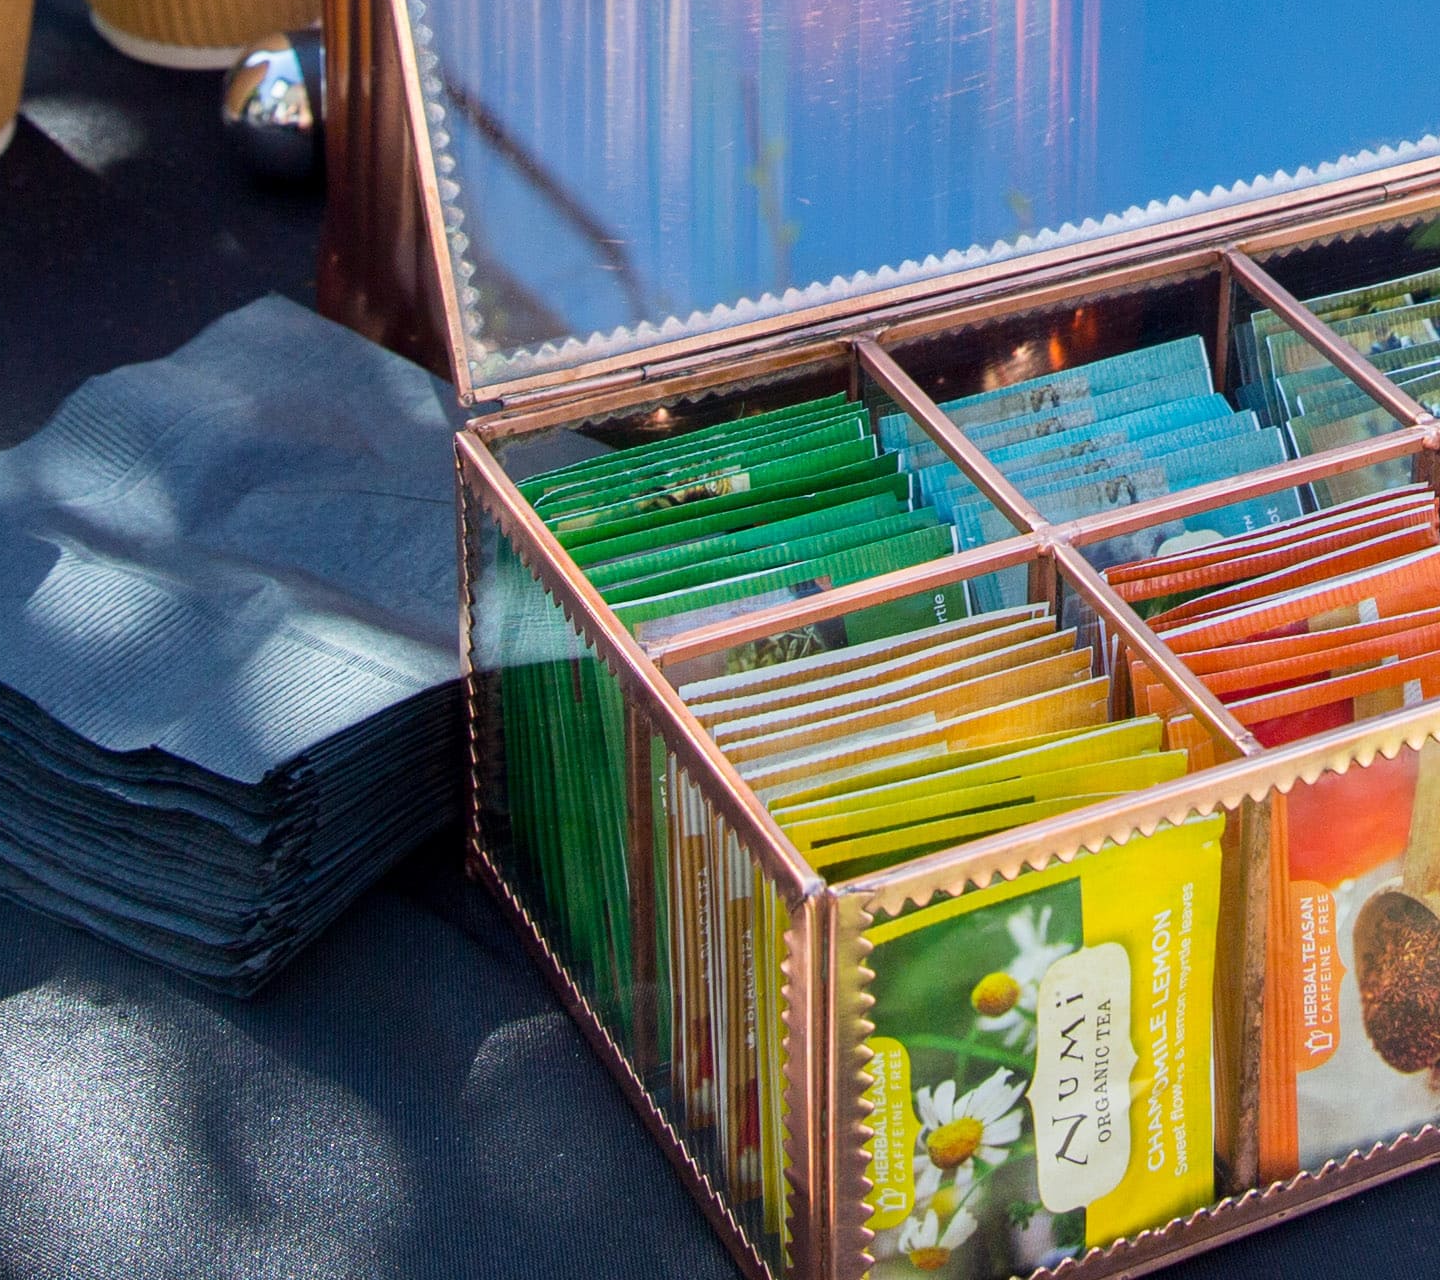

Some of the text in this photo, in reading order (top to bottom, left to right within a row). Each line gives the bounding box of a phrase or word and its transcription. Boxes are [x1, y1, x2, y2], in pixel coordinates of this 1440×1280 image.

[1177, 937, 1192, 991] myrtle
[1178, 881, 1194, 937] leaves
[1300, 896, 1318, 1027] HERBAL TEASAN
[1317, 892, 1333, 1025] CAFFEINE FREE
[1093, 998, 1111, 1143] ORGANIC TEA
[1146, 908, 1172, 1173] CHAMOMILE LEMON
[1174, 991, 1187, 1046] lemon
[871, 1051, 889, 1184] HERBAL TEASAN
[889, 1048, 906, 1183] CAFFEINE FREE
[1172, 1121, 1188, 1178] Sweet
